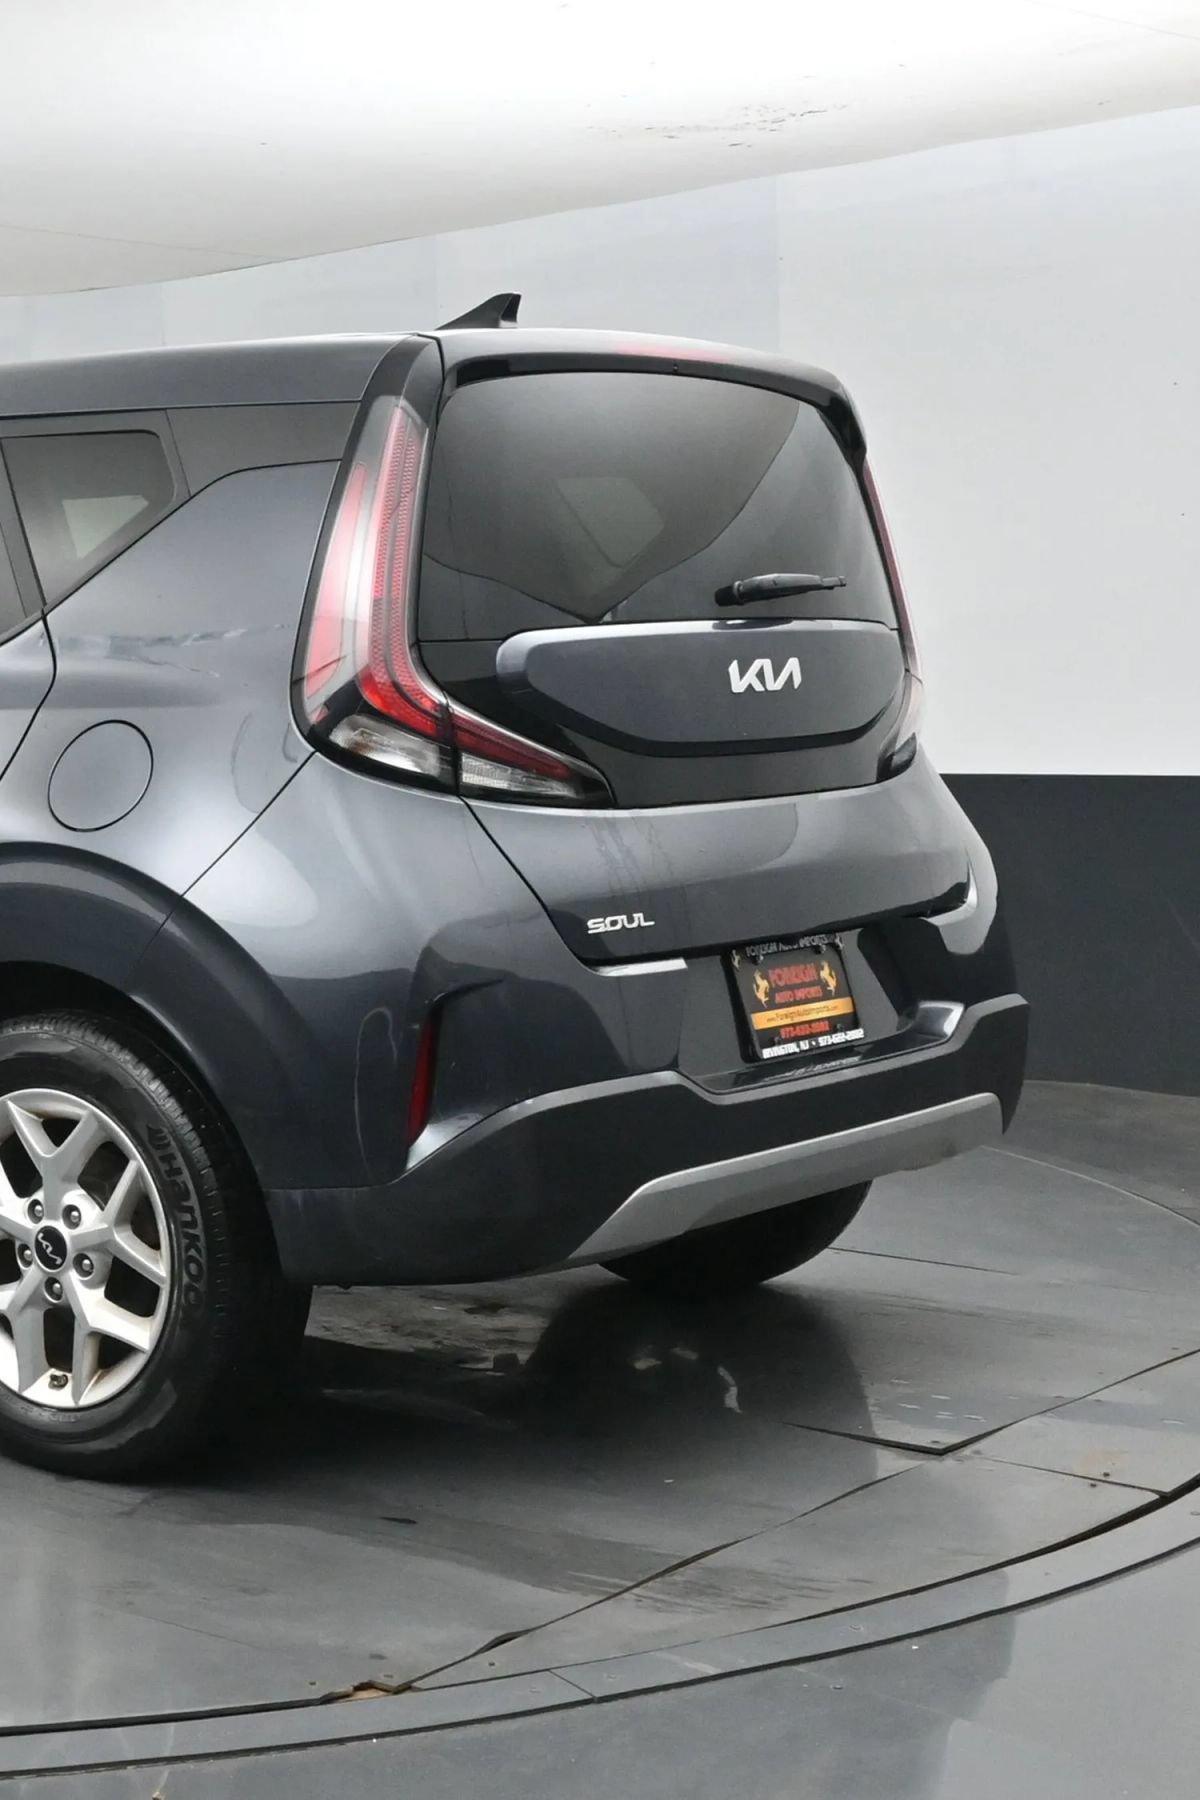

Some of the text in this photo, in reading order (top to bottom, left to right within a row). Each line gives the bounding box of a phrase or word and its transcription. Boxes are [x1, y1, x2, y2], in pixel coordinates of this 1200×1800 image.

[728, 657, 801, 693] KIA
[587, 912, 655, 934] SOUL
[768, 963, 817, 988] FOREIGN
